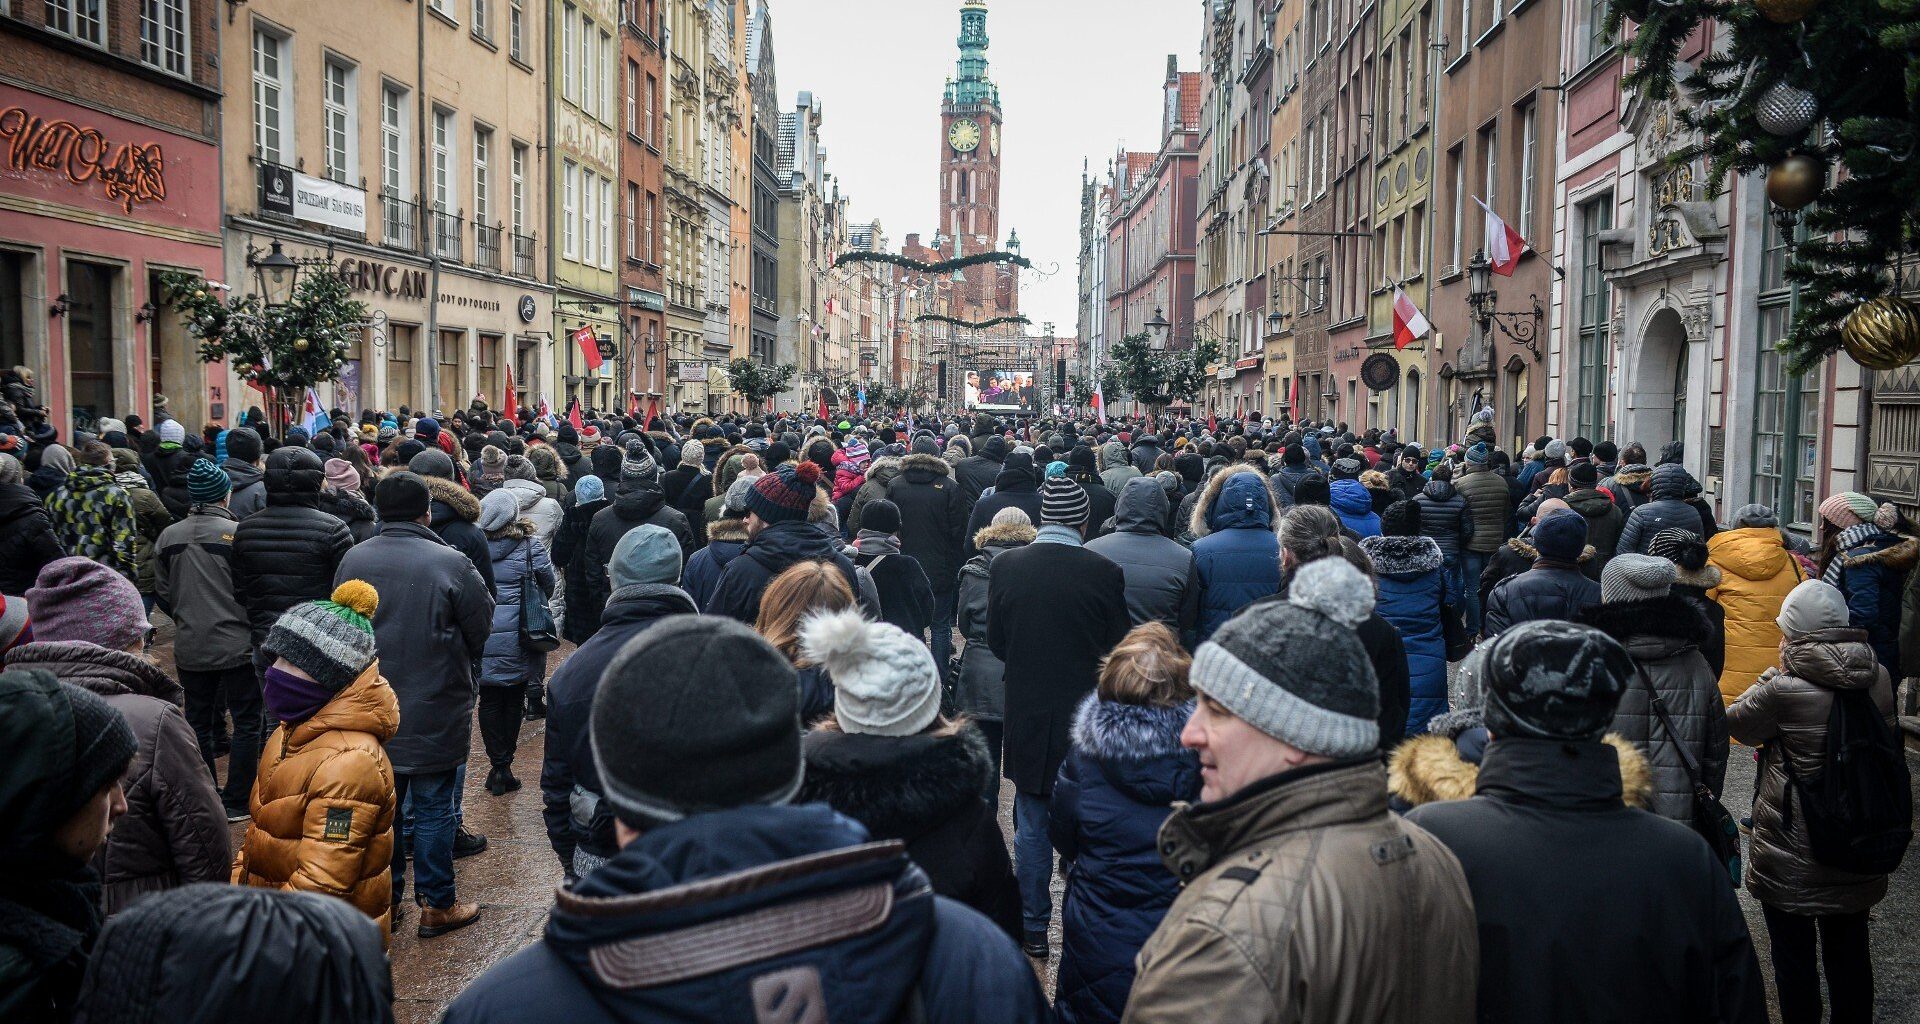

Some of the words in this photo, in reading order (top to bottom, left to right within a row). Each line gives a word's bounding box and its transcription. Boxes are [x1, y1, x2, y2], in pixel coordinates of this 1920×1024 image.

[0, 105, 77, 171] Wild
[297, 189, 329, 210] SPRZEDAM
[338, 257, 428, 300] GRYCAN
[457, 296, 467, 307] OD
[469, 298, 500, 312] POKOLEŃ
[210, 386, 221, 400] 74
